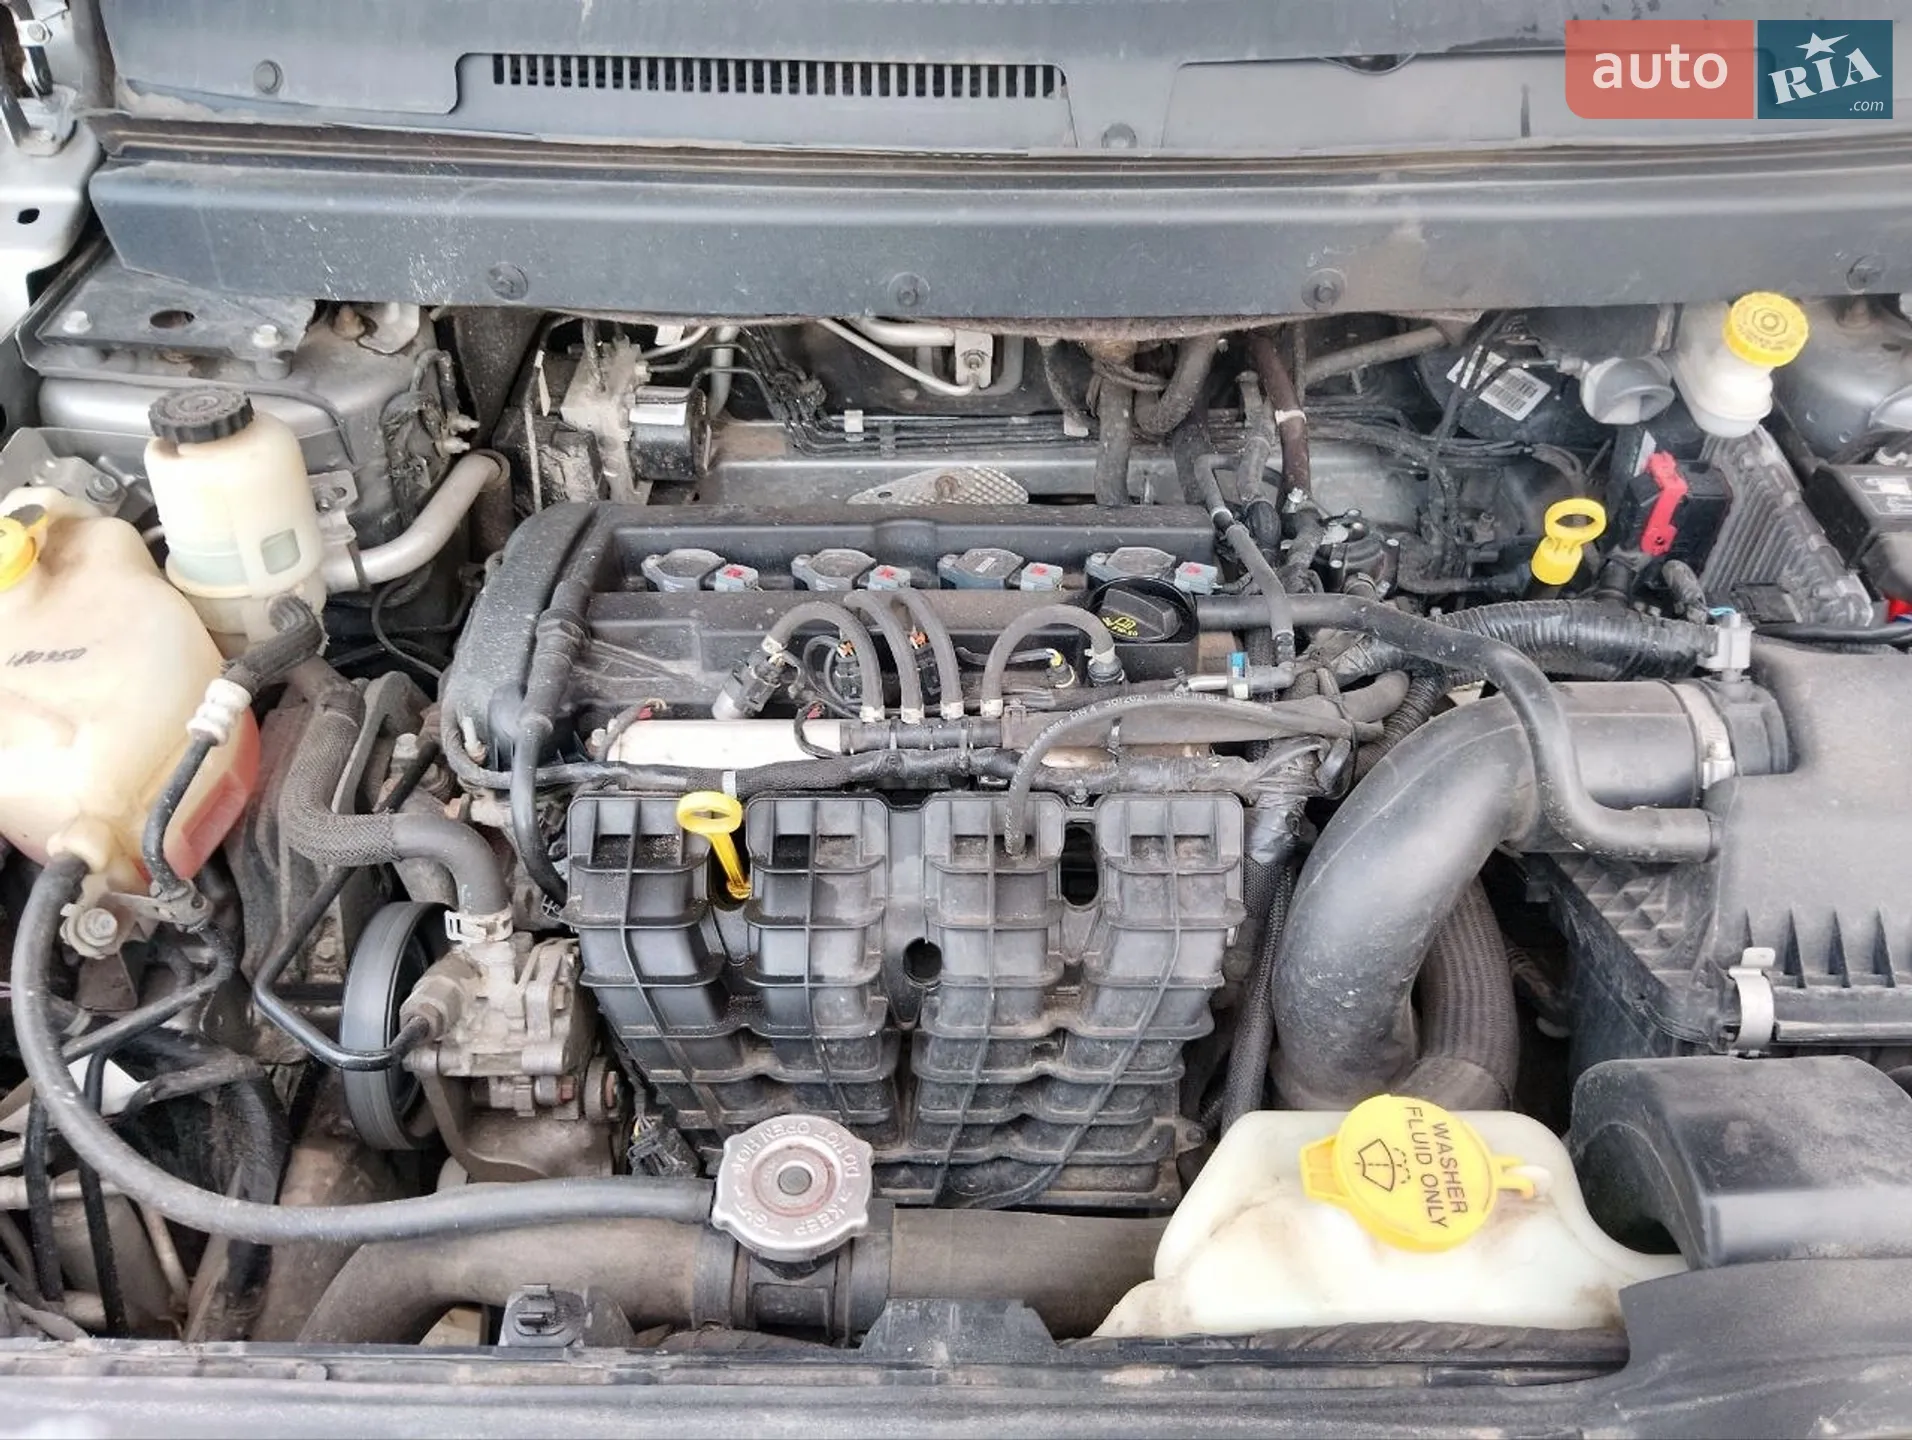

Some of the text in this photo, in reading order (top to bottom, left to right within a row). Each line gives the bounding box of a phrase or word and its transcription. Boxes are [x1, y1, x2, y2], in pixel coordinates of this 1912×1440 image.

[761, 1121, 811, 1143] OPEN
[1405, 1106, 1448, 1228] FLUID ONLY
[1432, 1122, 1468, 1214] WASHER
